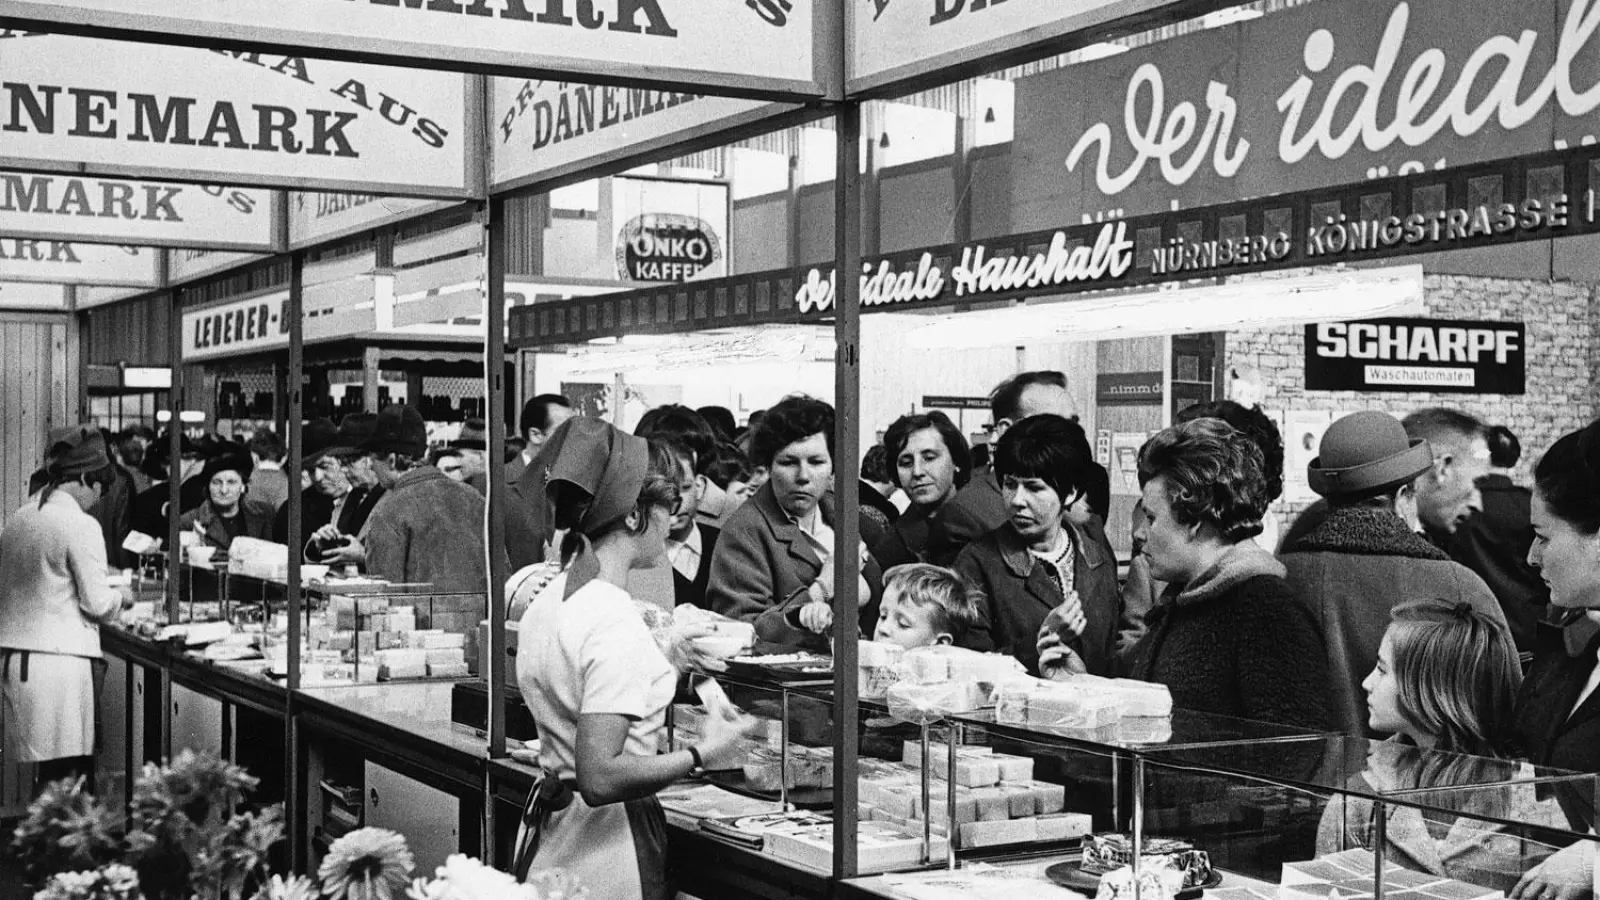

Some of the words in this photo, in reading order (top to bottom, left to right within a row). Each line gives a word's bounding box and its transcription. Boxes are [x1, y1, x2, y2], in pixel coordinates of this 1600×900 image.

[2, 82, 359, 158] NEMARK
[331, 78, 448, 148] AUS
[0, 174, 184, 223] MARK
[860, 251, 945, 306] ideale
[952, 221, 1134, 297] Haushalt
[1152, 231, 1290, 274] NÜRNBERG
[1306, 194, 1568, 256] KÖNIGSTRASSE
[1317, 322, 1519, 364] SCHARPF
[1369, 366, 1473, 383] Waschautomaten
